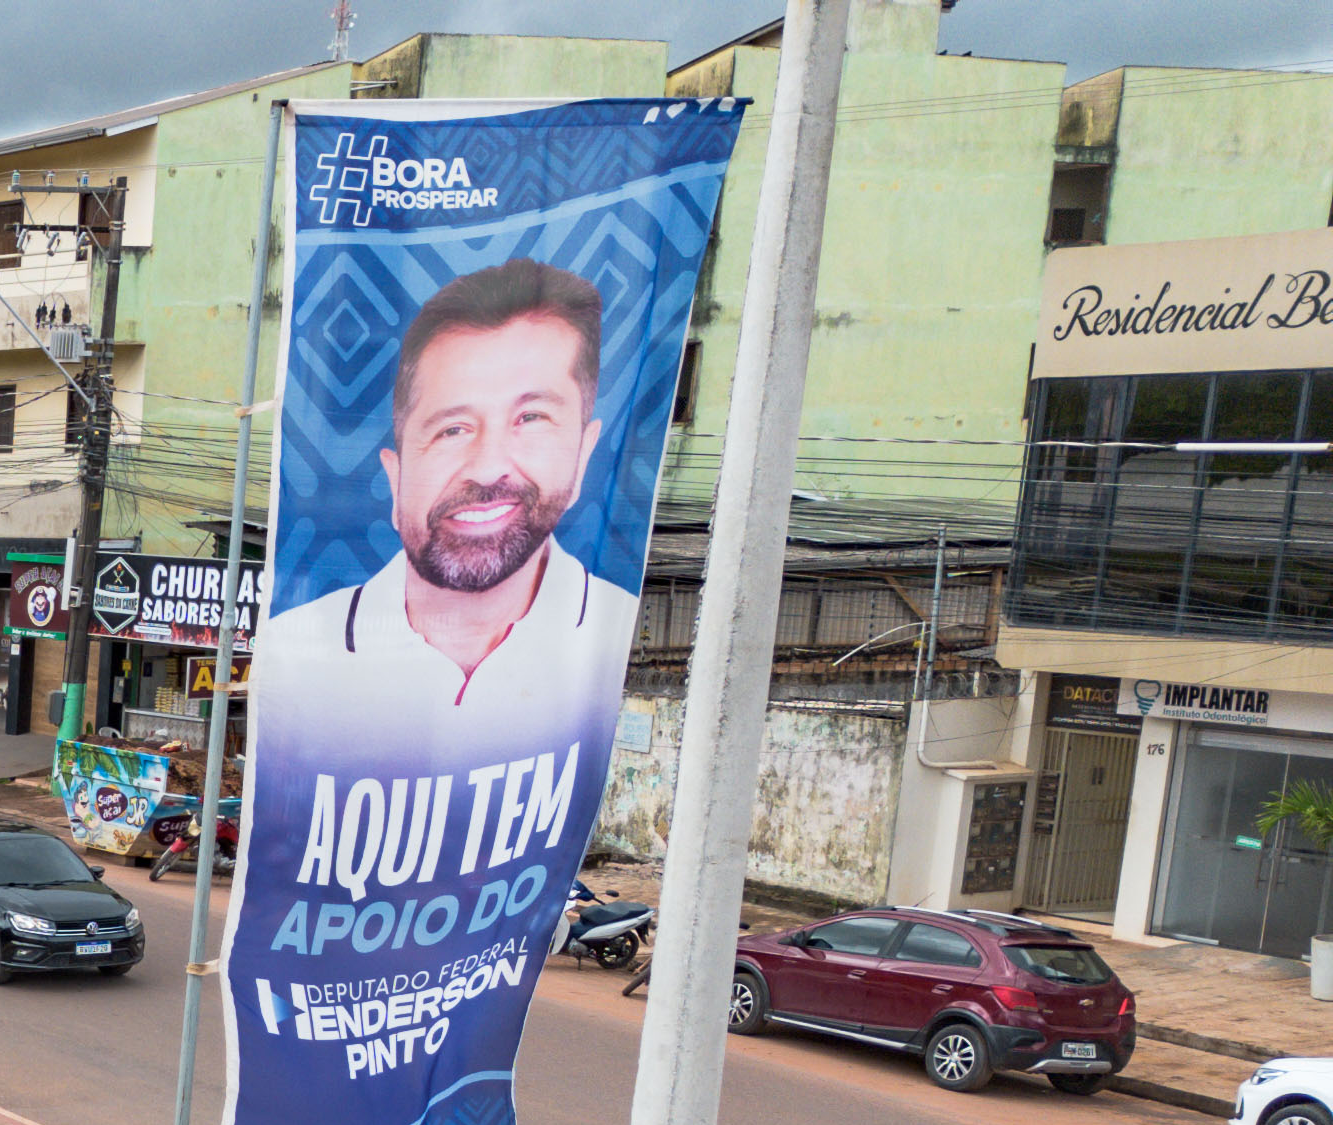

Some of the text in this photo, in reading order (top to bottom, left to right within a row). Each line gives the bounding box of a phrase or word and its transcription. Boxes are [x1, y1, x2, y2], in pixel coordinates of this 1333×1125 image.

[372, 187, 497, 210] PROSPERAR
[1053, 273, 1275, 341] Residencial
[142, 597, 221, 627] SABORES
[1163, 707, 1267, 724] Instituto Odontológico
[1165, 683, 1269, 713] IMPLANTAR
[1147, 744, 1165, 755] 176
[297, 742, 579, 901] AQUI TEM
[270, 865, 547, 955] APOIO DO
[308, 935, 529, 1005] DEPUTADO FEDERAL
[347, 1017, 450, 1080] PINTO
